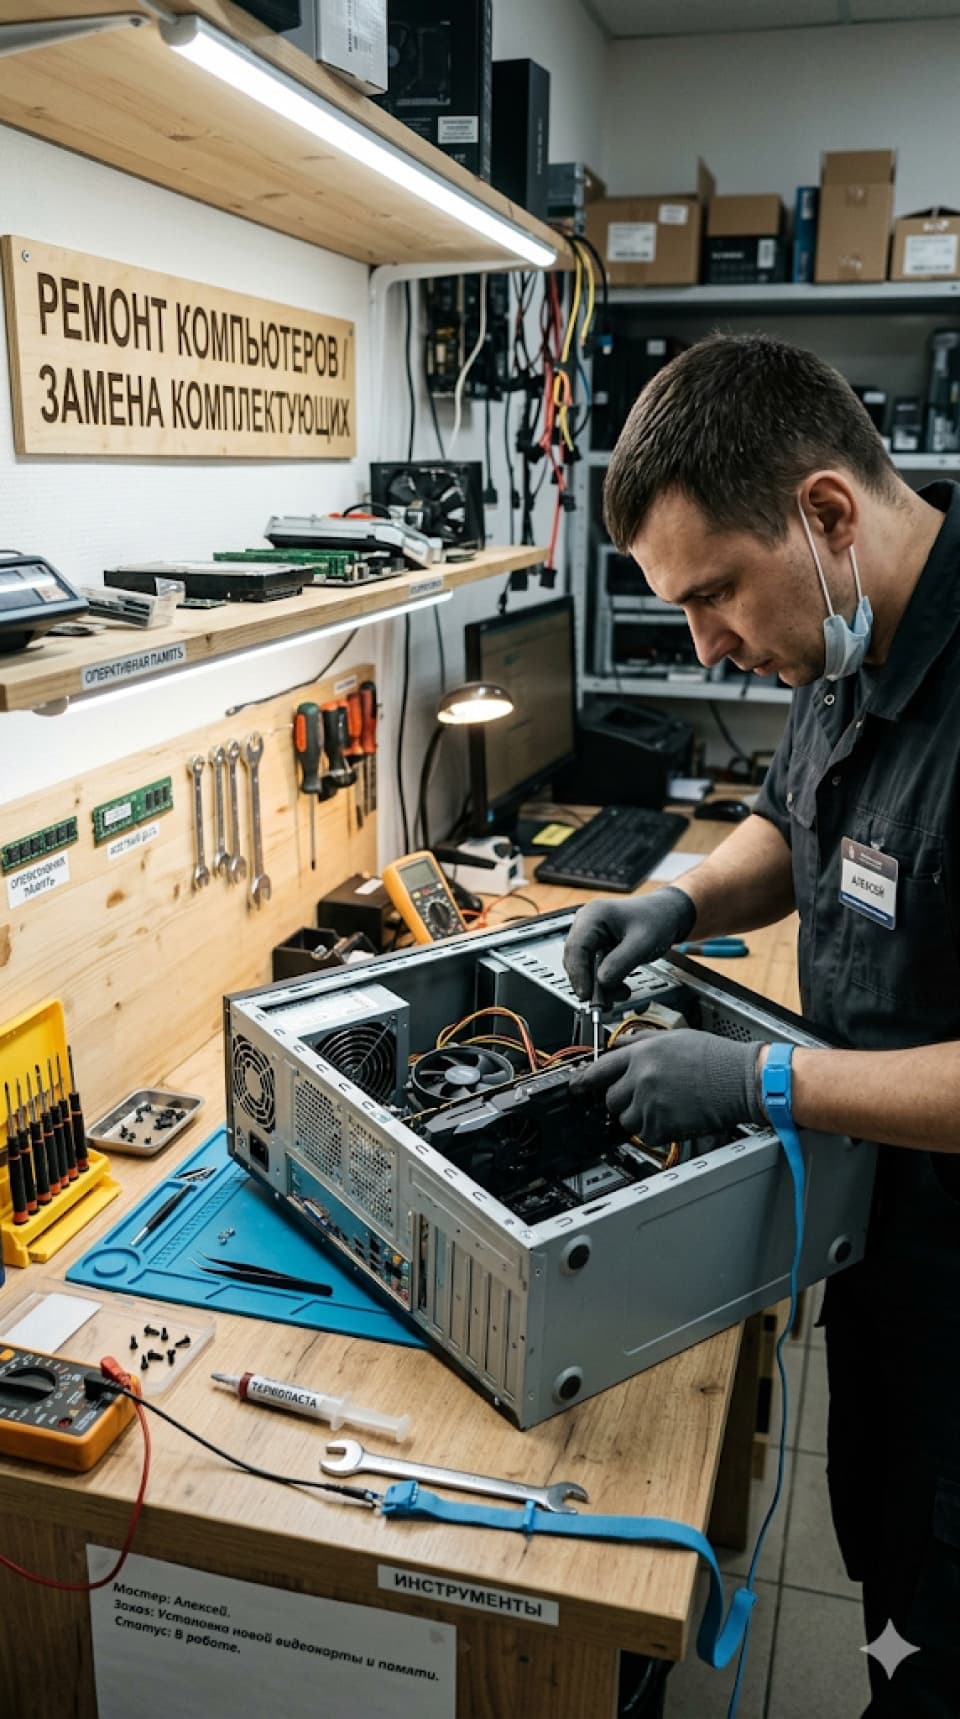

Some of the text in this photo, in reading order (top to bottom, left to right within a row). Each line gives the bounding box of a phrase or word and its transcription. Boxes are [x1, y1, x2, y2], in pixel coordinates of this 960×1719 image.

[37, 272, 167, 353] РЕМОНТ
[176, 302, 338, 378] КОМПЬЮТЕРОВ
[39, 364, 350, 444] ЗАМЕНА КОМПЛЕКТУЮЩИХ
[395, 1573, 543, 1617] ИНСТРУМЕНТЫ
[175, 1629, 183, 1639] В
[233, 1627, 273, 1644] новой
[366, 1657, 375, 1667] и
